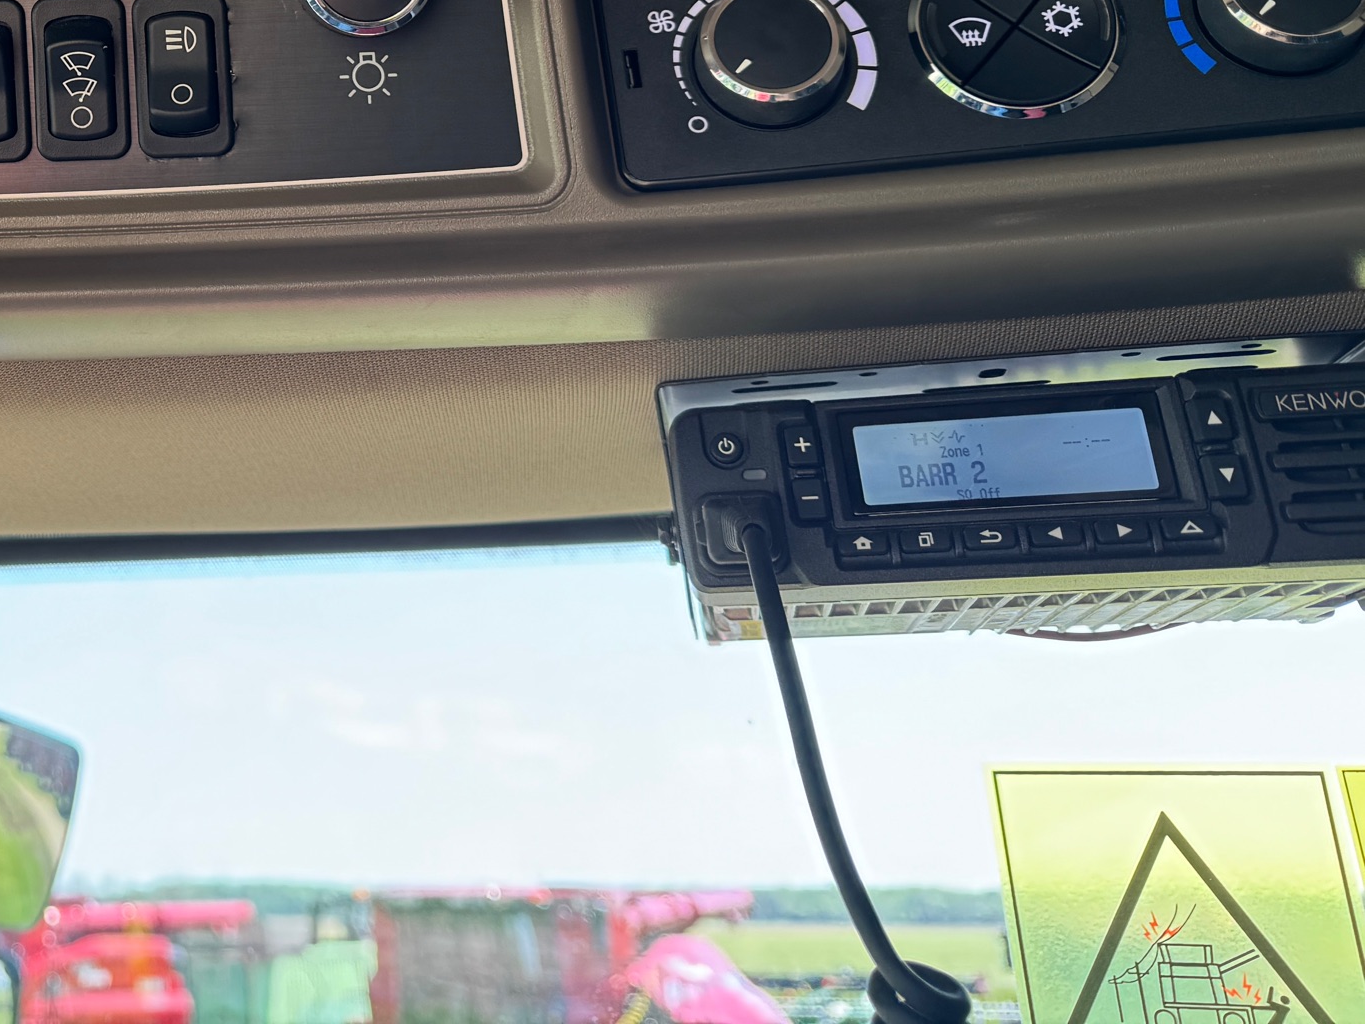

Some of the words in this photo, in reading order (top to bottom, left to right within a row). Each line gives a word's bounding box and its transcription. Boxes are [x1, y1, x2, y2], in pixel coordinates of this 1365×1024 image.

[939, 445, 971, 458] Zone
[976, 443, 984, 456] 1
[898, 462, 958, 488] BARR
[970, 460, 988, 484] 2
